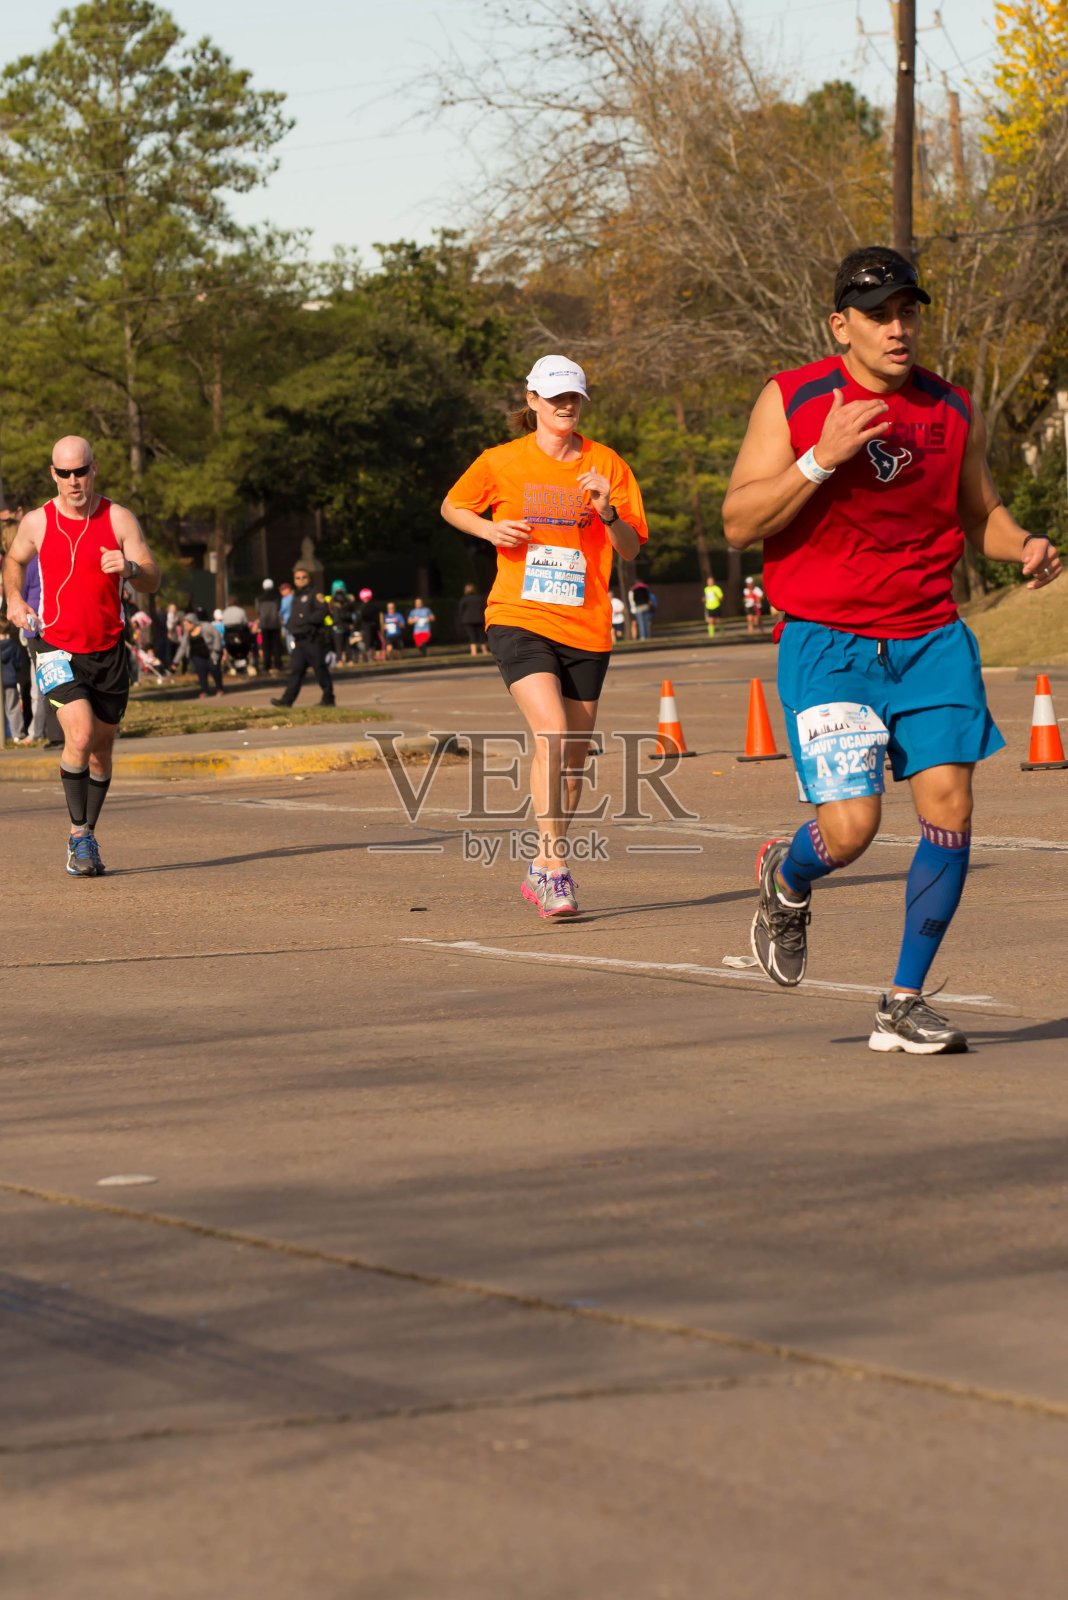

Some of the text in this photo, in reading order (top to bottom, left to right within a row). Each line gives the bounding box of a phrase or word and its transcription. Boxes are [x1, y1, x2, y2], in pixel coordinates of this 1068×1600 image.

[523, 490, 583, 508] SUCCESS
[523, 504, 576, 518] HOUSTON
[525, 567, 585, 583] RACHEL MAGUIRE
[530, 578, 578, 598] A 2690
[816, 747, 878, 779] A 3236
